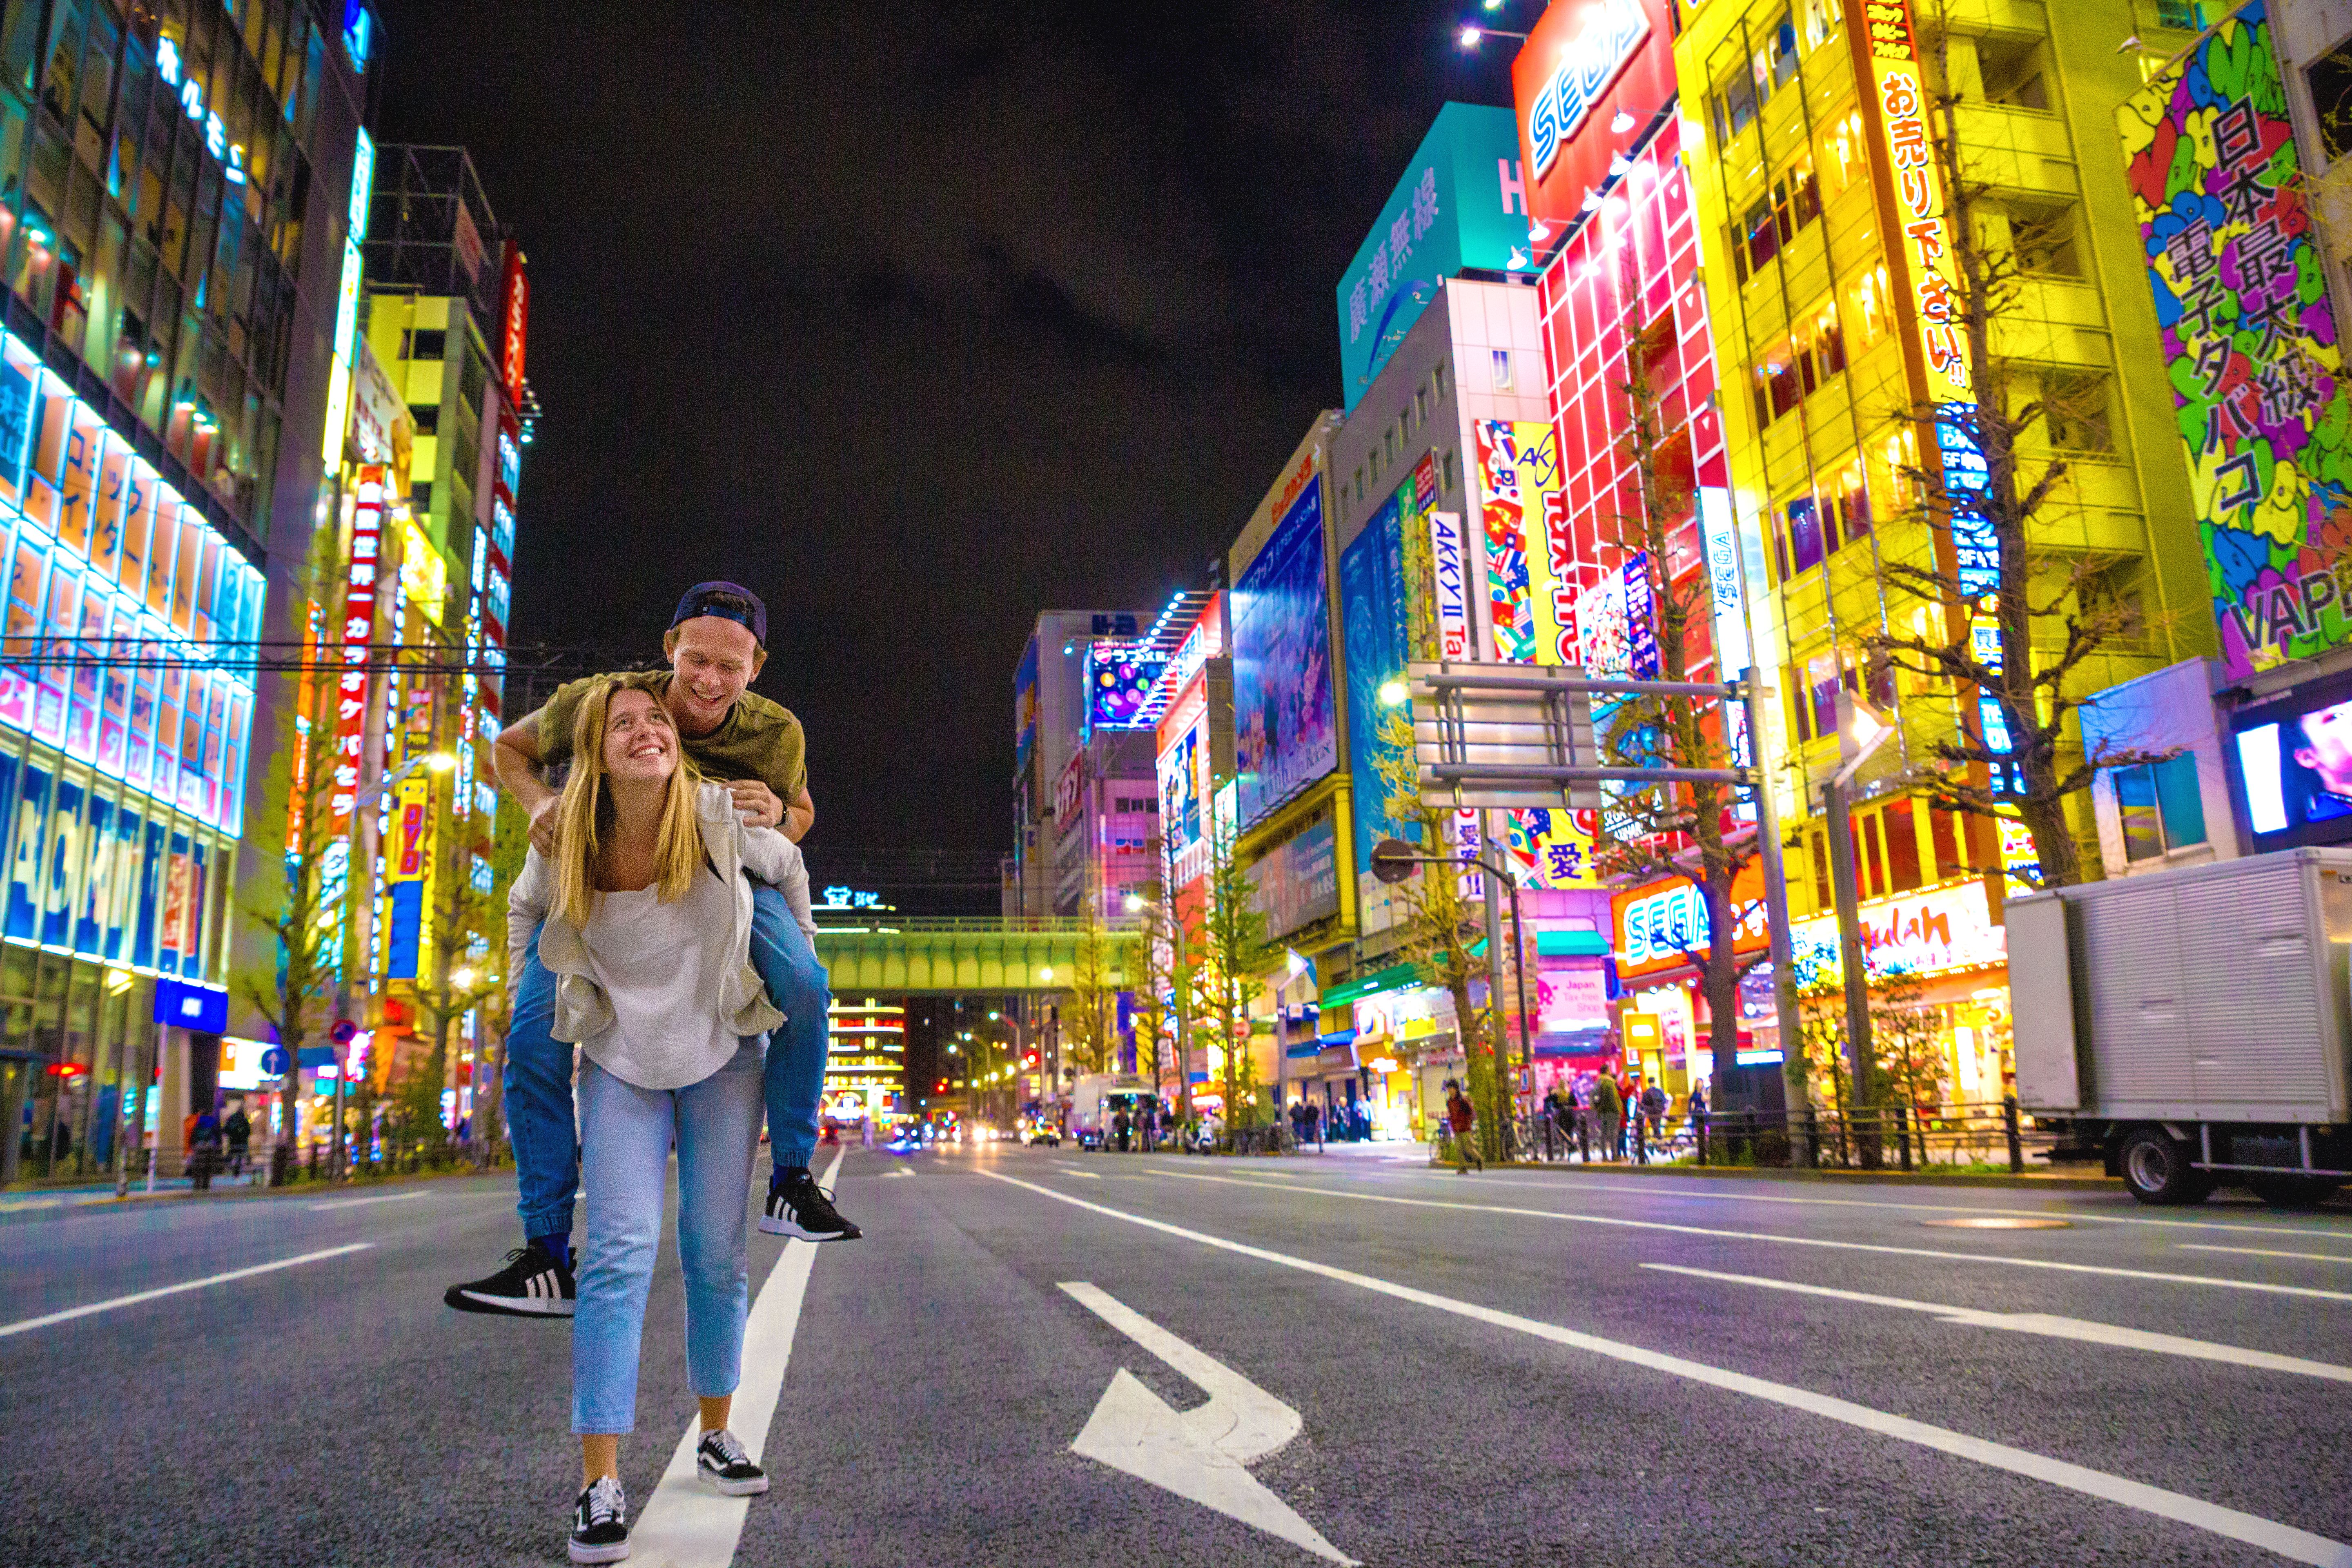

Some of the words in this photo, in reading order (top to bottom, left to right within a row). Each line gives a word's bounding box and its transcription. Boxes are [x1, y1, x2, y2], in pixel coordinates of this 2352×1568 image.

[1530, 1, 1648, 178] SEGA
[2167, 216, 2263, 512] 電子タバコ
[1434, 518, 1463, 599] AKKY
[399, 803, 423, 875] DVD
[1624, 884, 1711, 966] SEGA
